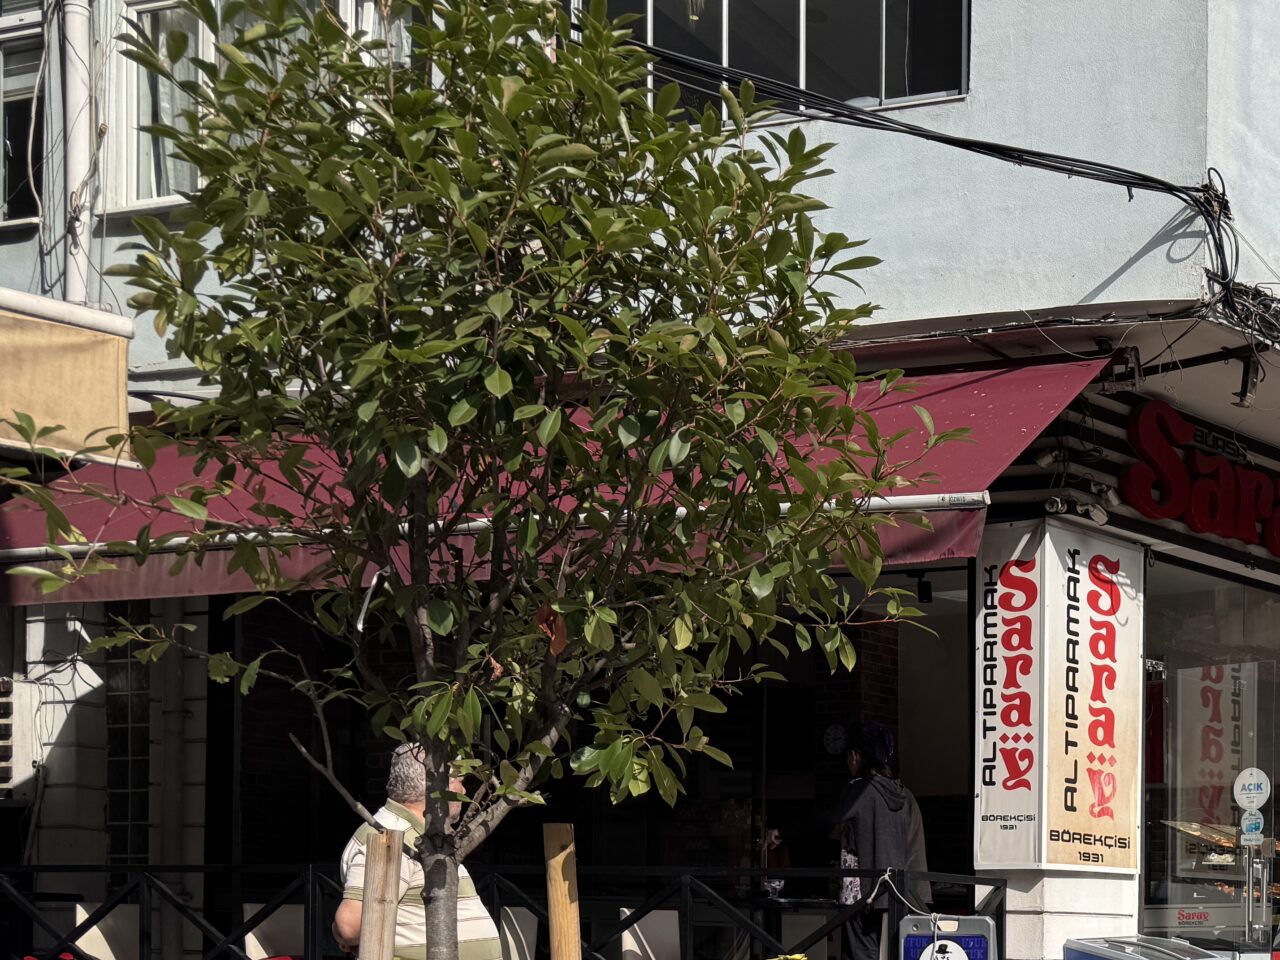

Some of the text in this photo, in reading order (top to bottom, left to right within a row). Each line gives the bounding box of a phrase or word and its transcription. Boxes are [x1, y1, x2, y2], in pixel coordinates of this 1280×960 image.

[982, 565, 998, 787] ALTIPARMAK
[998, 556, 1038, 791] Saray
[1064, 548, 1081, 812] ALTIPARMAK
[1086, 554, 1121, 820] Saray
[1049, 829, 1131, 849] BÖREKÇİSİ
[1241, 783, 1263, 792] AÇIK
[1078, 851, 1104, 863] 1931
[1177, 907, 1209, 921] Saray
